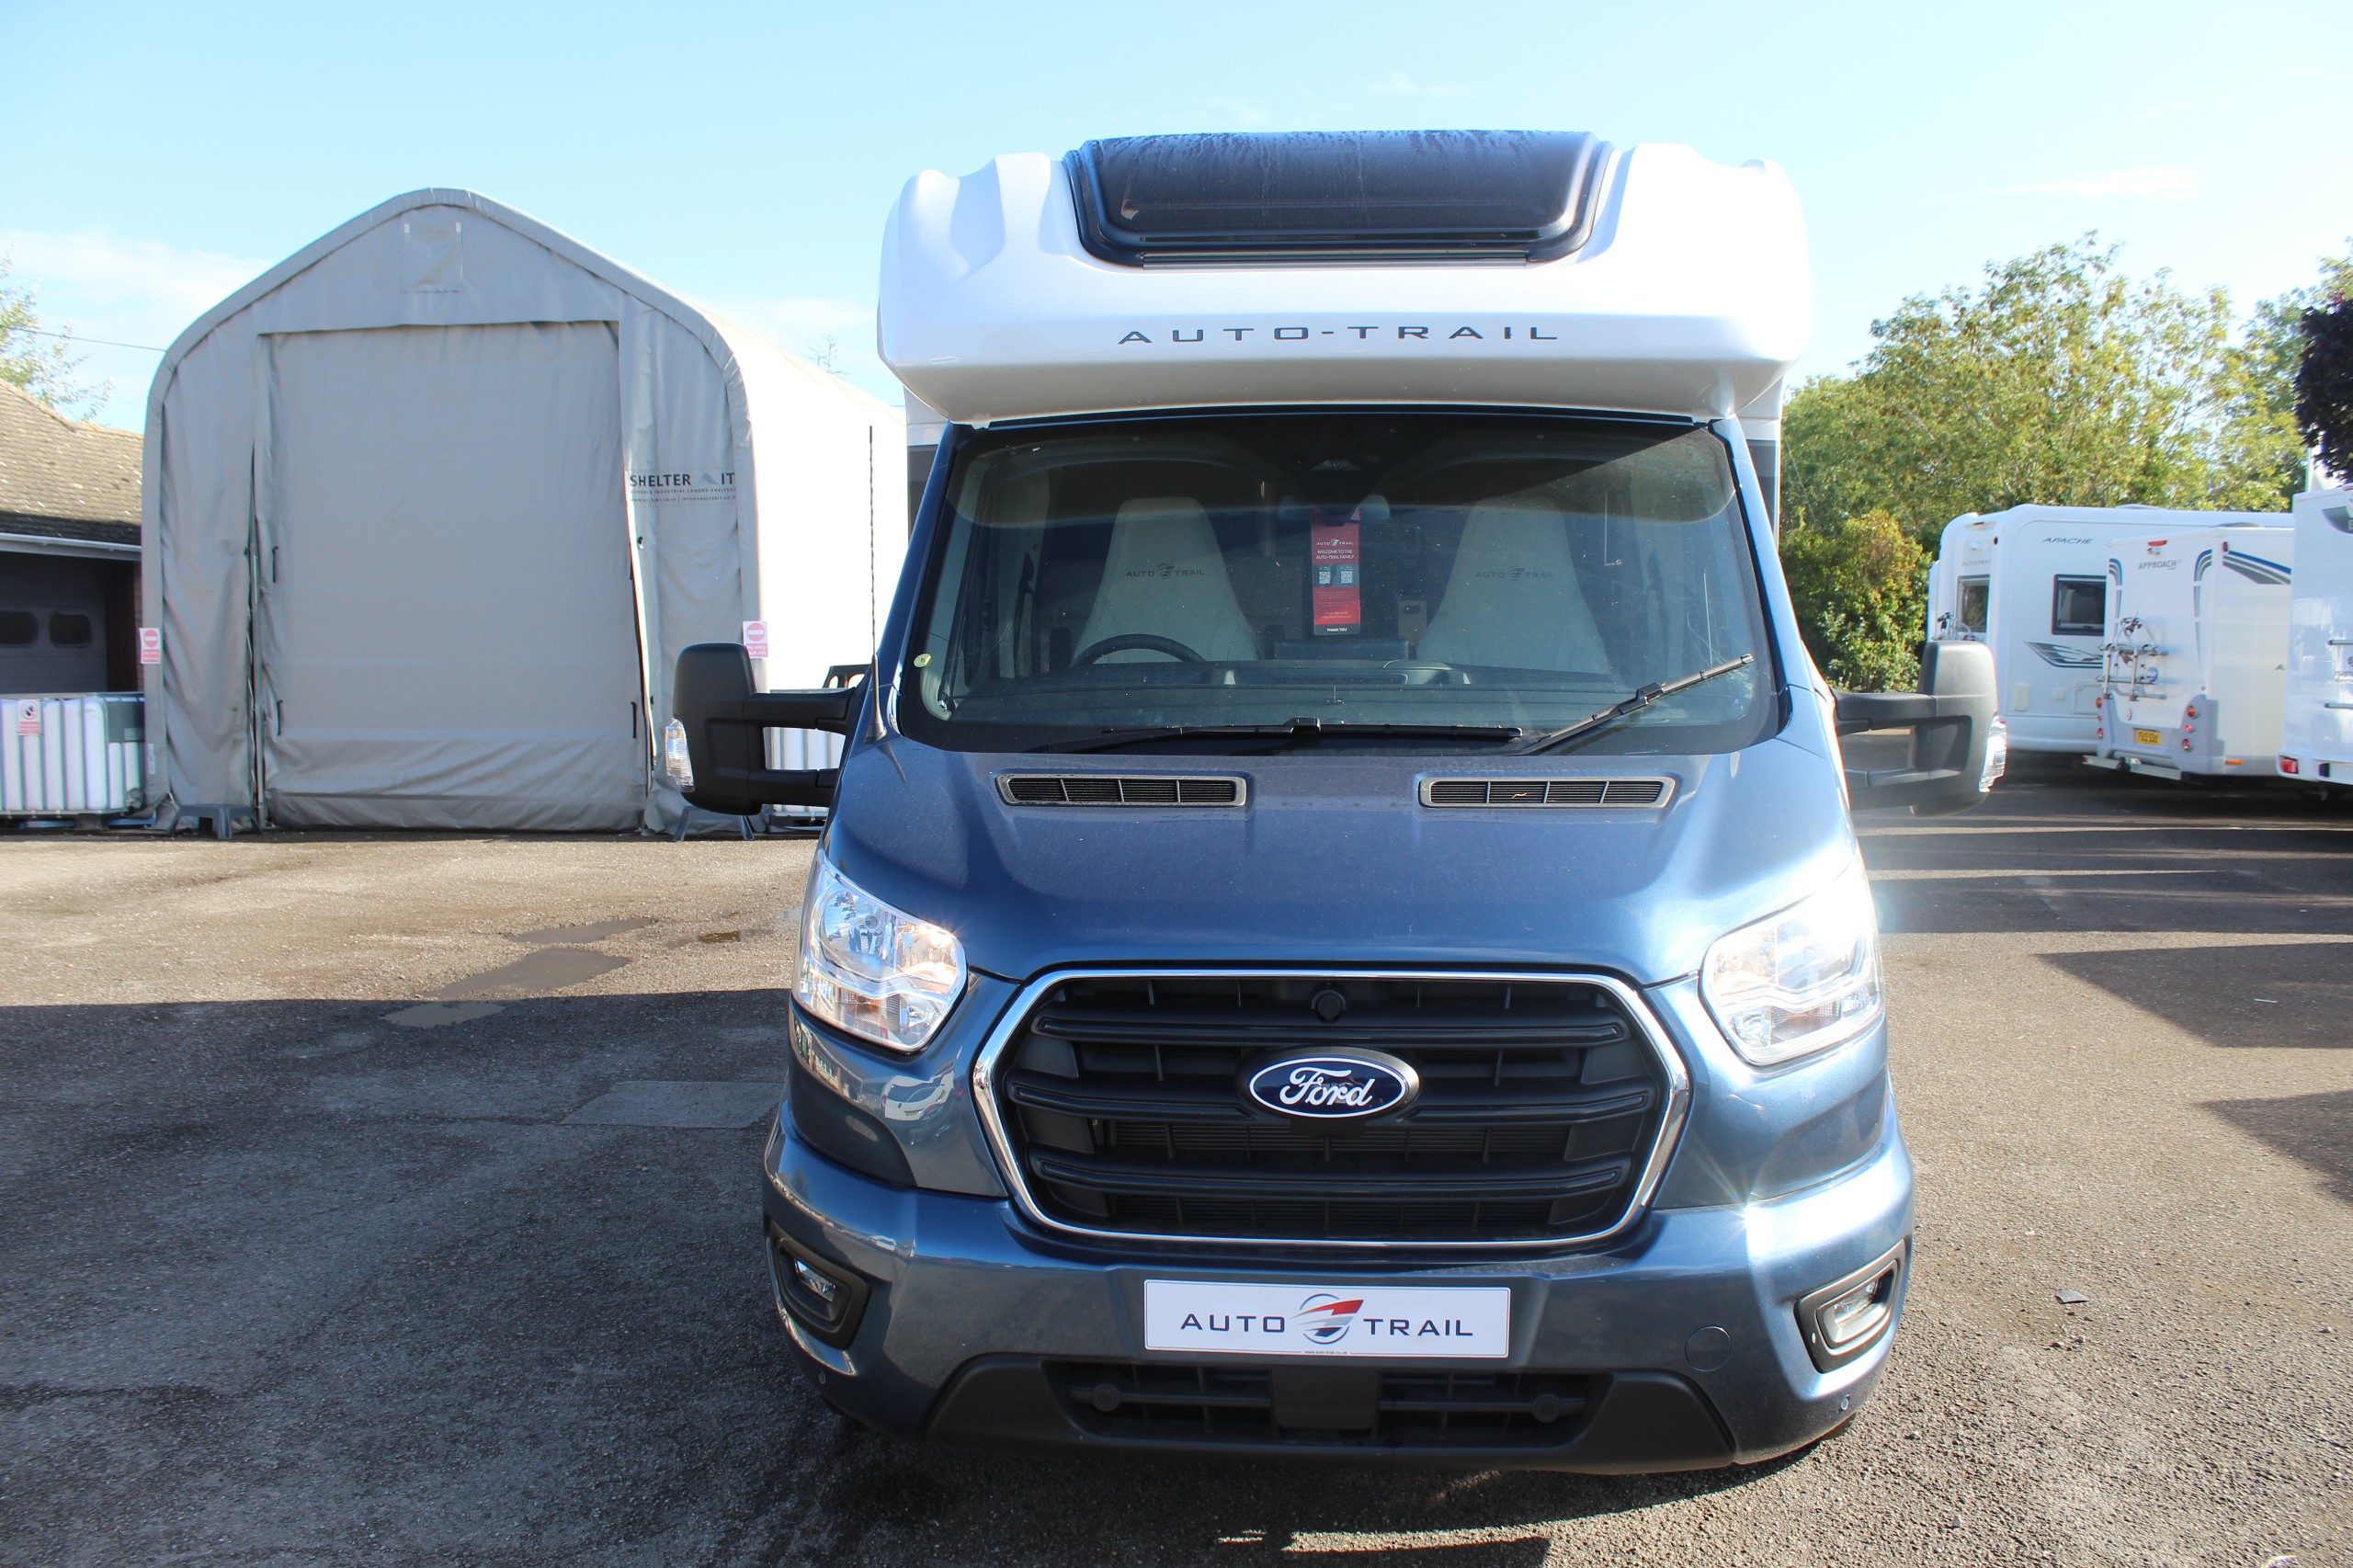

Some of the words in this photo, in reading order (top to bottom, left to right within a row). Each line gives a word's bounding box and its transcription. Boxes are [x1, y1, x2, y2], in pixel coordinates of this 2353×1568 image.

[1118, 325, 1558, 345] AUTO-TRAIL
[630, 473, 691, 487] SHELTER
[721, 472, 735, 485] IT
[2138, 560, 2177, 569] APPROACH
[1279, 1067, 1376, 1107] Ford
[1180, 1313, 1285, 1334] AUTO
[1362, 1318, 1474, 1336] TRAIL
